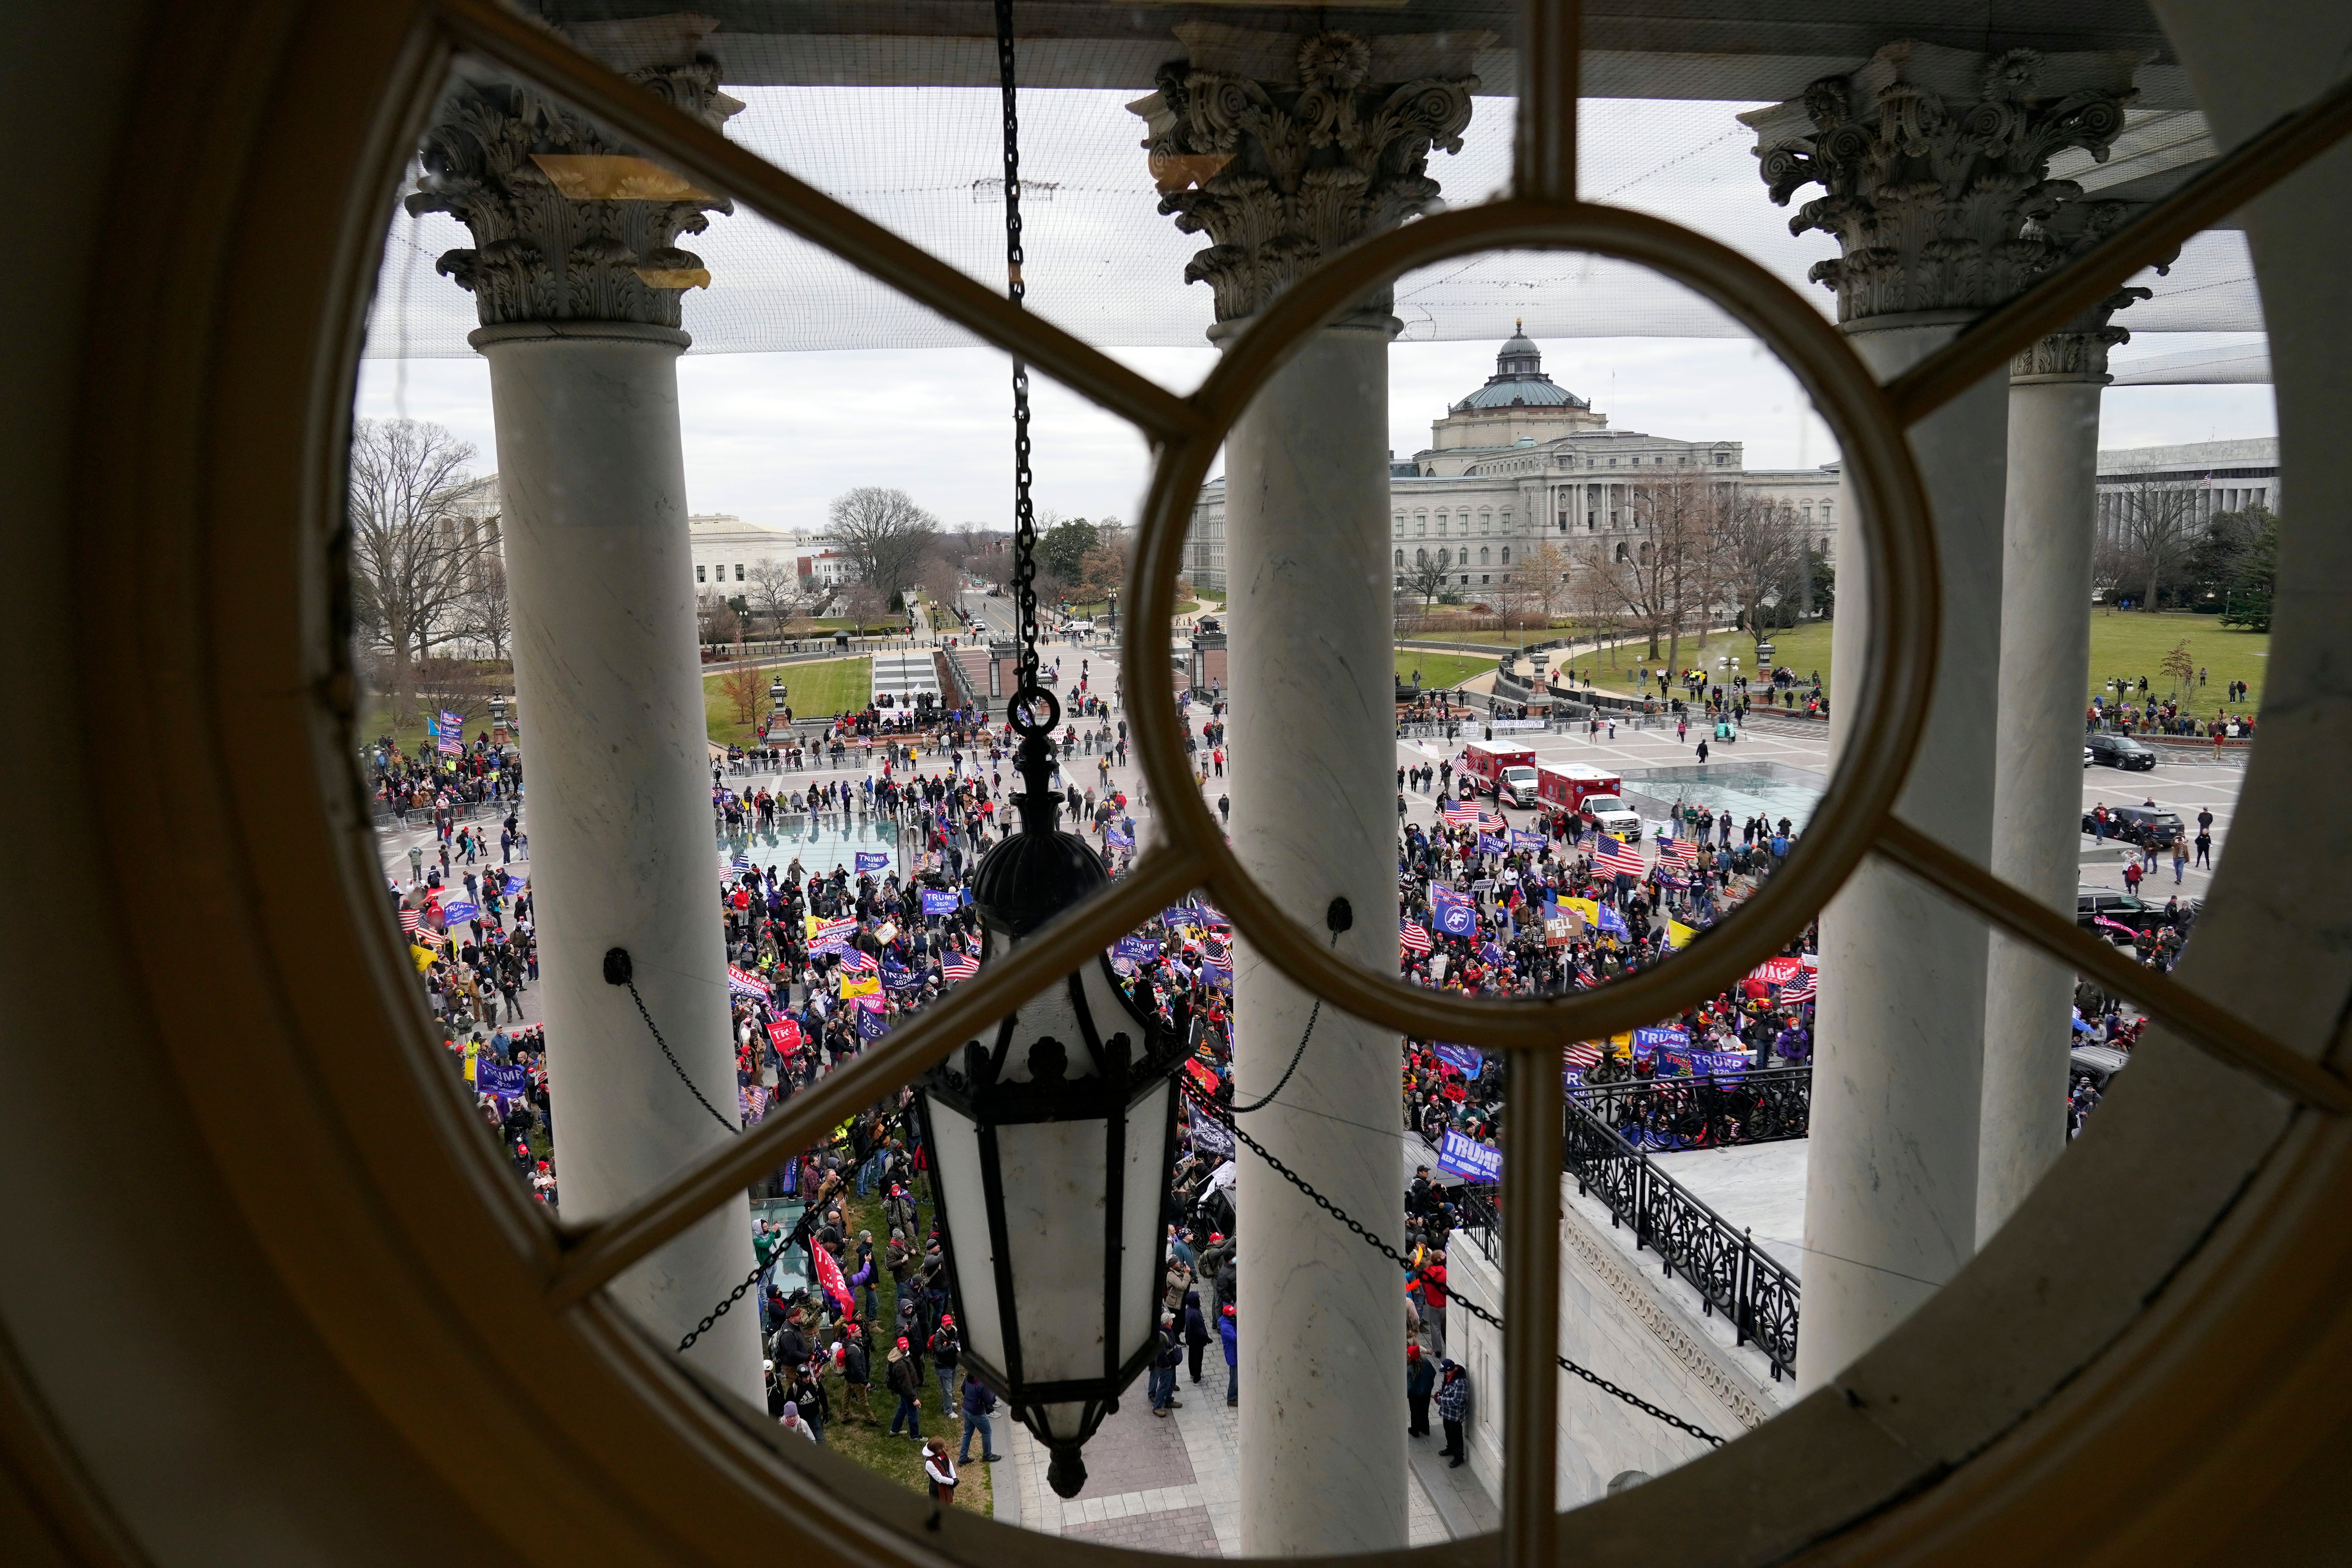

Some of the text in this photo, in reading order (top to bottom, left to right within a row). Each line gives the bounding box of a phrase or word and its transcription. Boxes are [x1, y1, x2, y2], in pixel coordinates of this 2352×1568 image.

[1399, 872, 1416, 882] UMP
[1435, 889, 1460, 899] FLORIDA
[1447, 912, 1466, 925] AF
[1546, 917, 1572, 931] HELL
[1555, 929, 1566, 937] NO
[1546, 936, 1568, 946] NEVER
[881, 968, 919, 980] TRUMP
[730, 984, 758, 995] 2020
[855, 998, 881, 1009] TRUMP
[1638, 1030, 1686, 1044] TRUMP
[1691, 1054, 1742, 1070] TRUMP
[482, 1064, 521, 1082] TRUMP
[1447, 1085, 1459, 1093] JOE
[1447, 1130, 1504, 1173] TRUMP
[1441, 1153, 1456, 1164] KEEP
[1456, 1160, 1481, 1176] AMERICA
[799, 1397, 815, 1406] adidas
